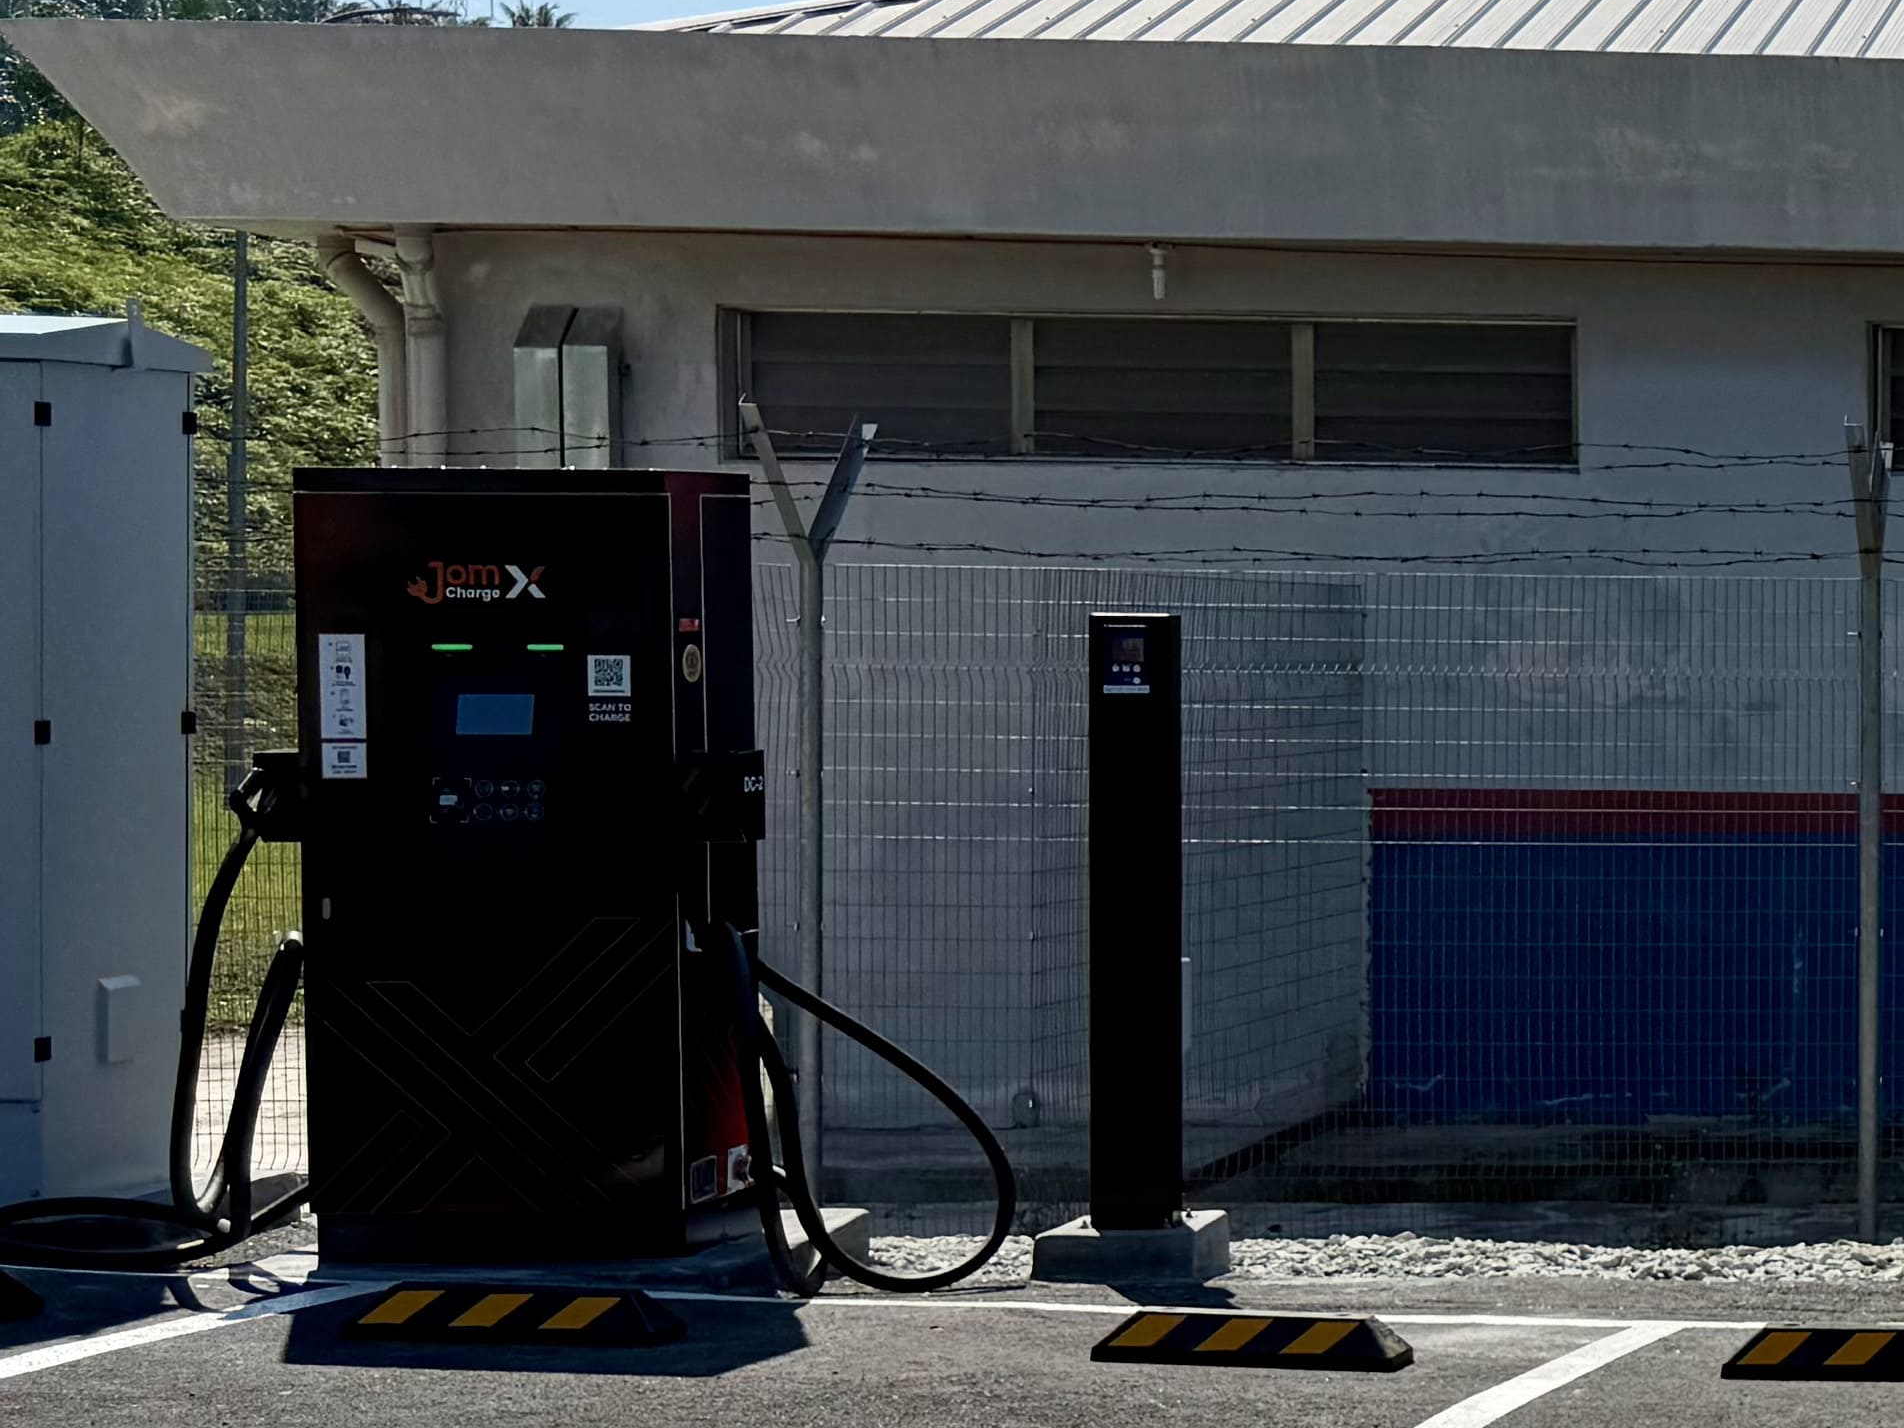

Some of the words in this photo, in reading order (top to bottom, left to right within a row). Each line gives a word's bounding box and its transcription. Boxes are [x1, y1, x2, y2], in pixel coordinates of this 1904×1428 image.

[407, 561, 501, 604] Jom
[504, 565, 546, 599] X
[445, 586, 501, 602] Charge
[588, 703, 616, 712] SCAN
[618, 703, 632, 712] TO
[588, 713, 632, 722] CHARGE
